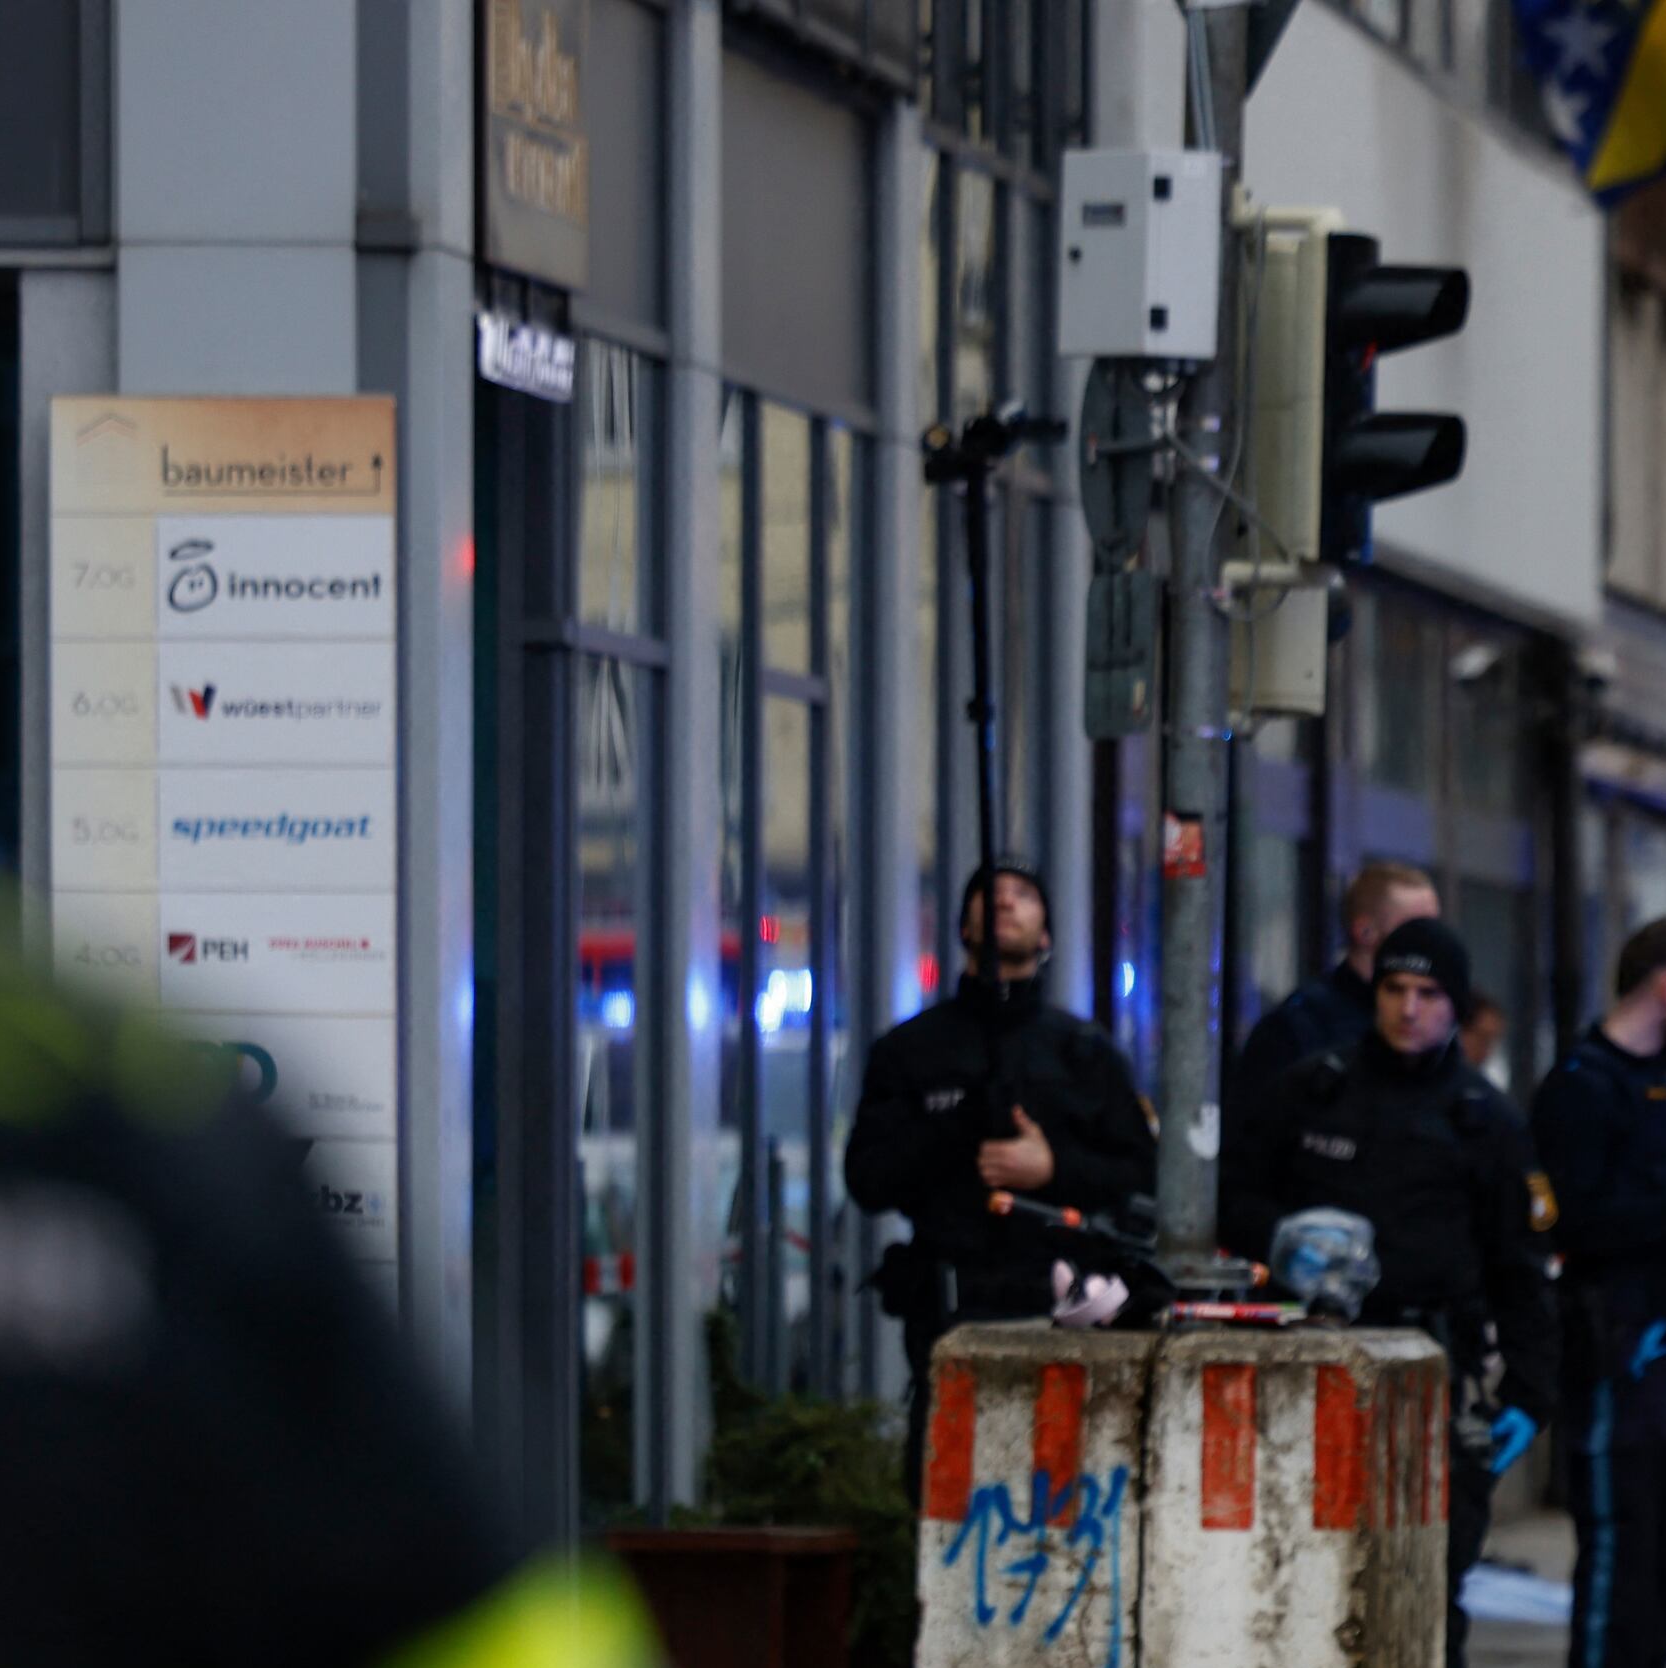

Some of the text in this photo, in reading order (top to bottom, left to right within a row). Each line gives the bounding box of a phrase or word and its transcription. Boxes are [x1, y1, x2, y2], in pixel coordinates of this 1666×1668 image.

[161, 444, 351, 488] baumeister
[228, 572, 381, 600] innocent
[172, 811, 370, 845] speedgoat
[202, 938, 249, 962] PEH
[315, 1183, 364, 1215] bz
